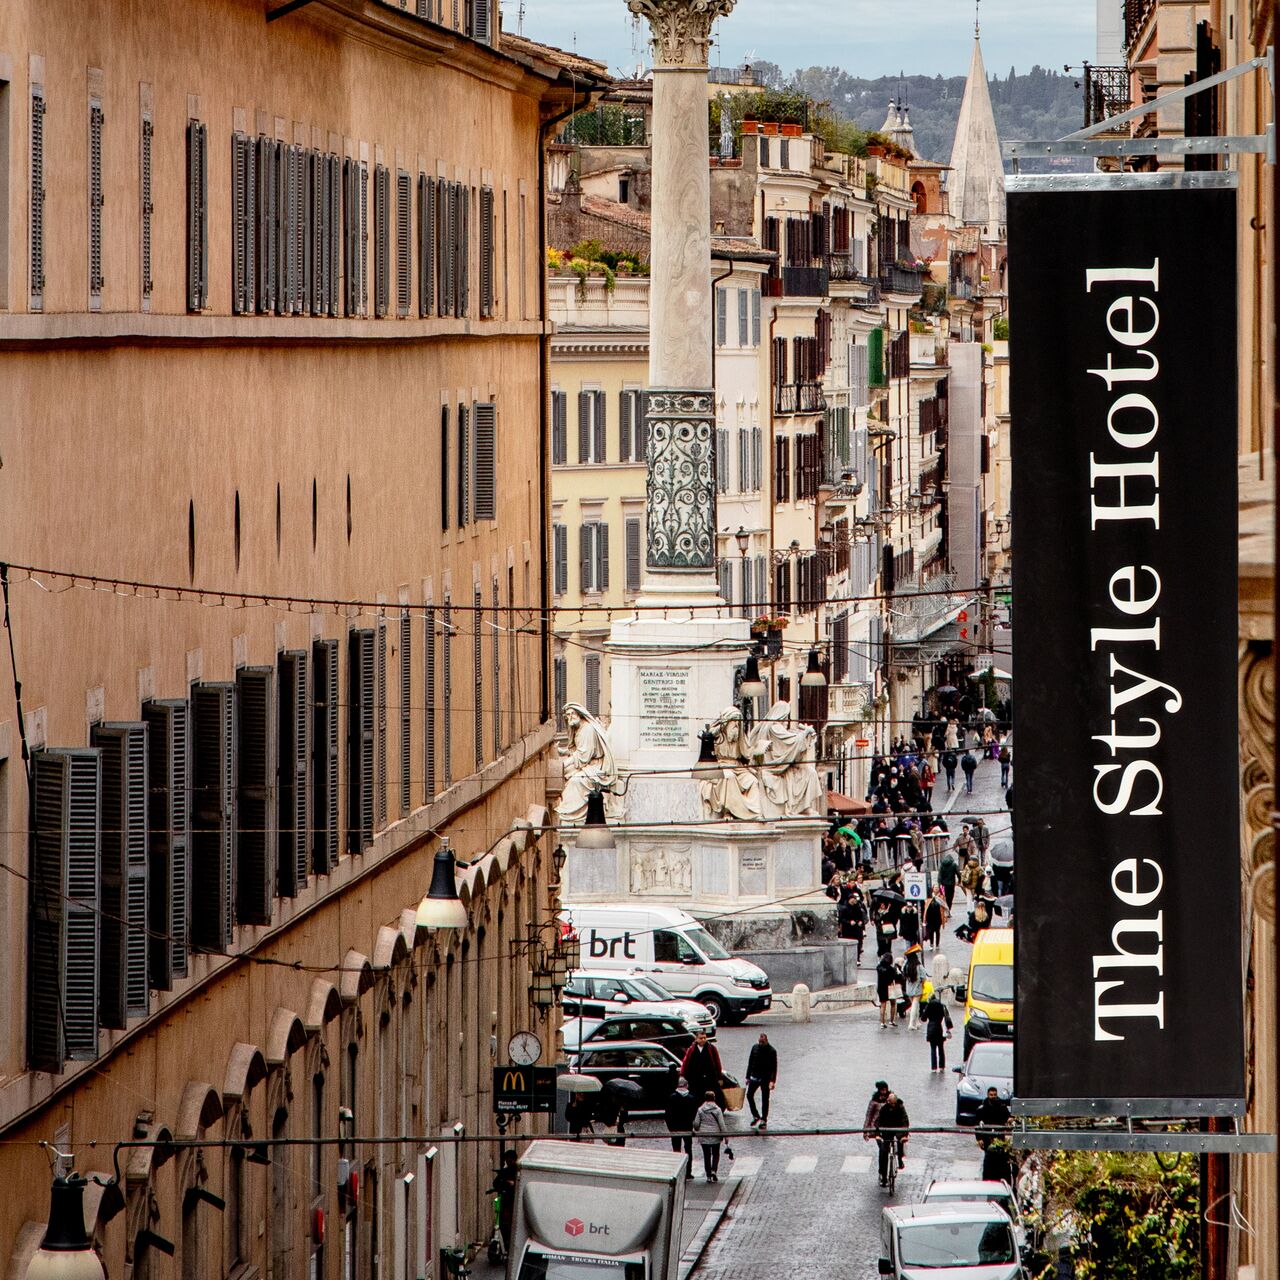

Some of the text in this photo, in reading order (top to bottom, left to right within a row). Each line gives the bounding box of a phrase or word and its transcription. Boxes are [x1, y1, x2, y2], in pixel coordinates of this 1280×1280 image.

[1085, 257, 1183, 1041] The Style Hotel
[589, 928, 636, 959] brt
[589, 1222, 610, 1235] brt
[541, 1253, 565, 1261] ROMAN
